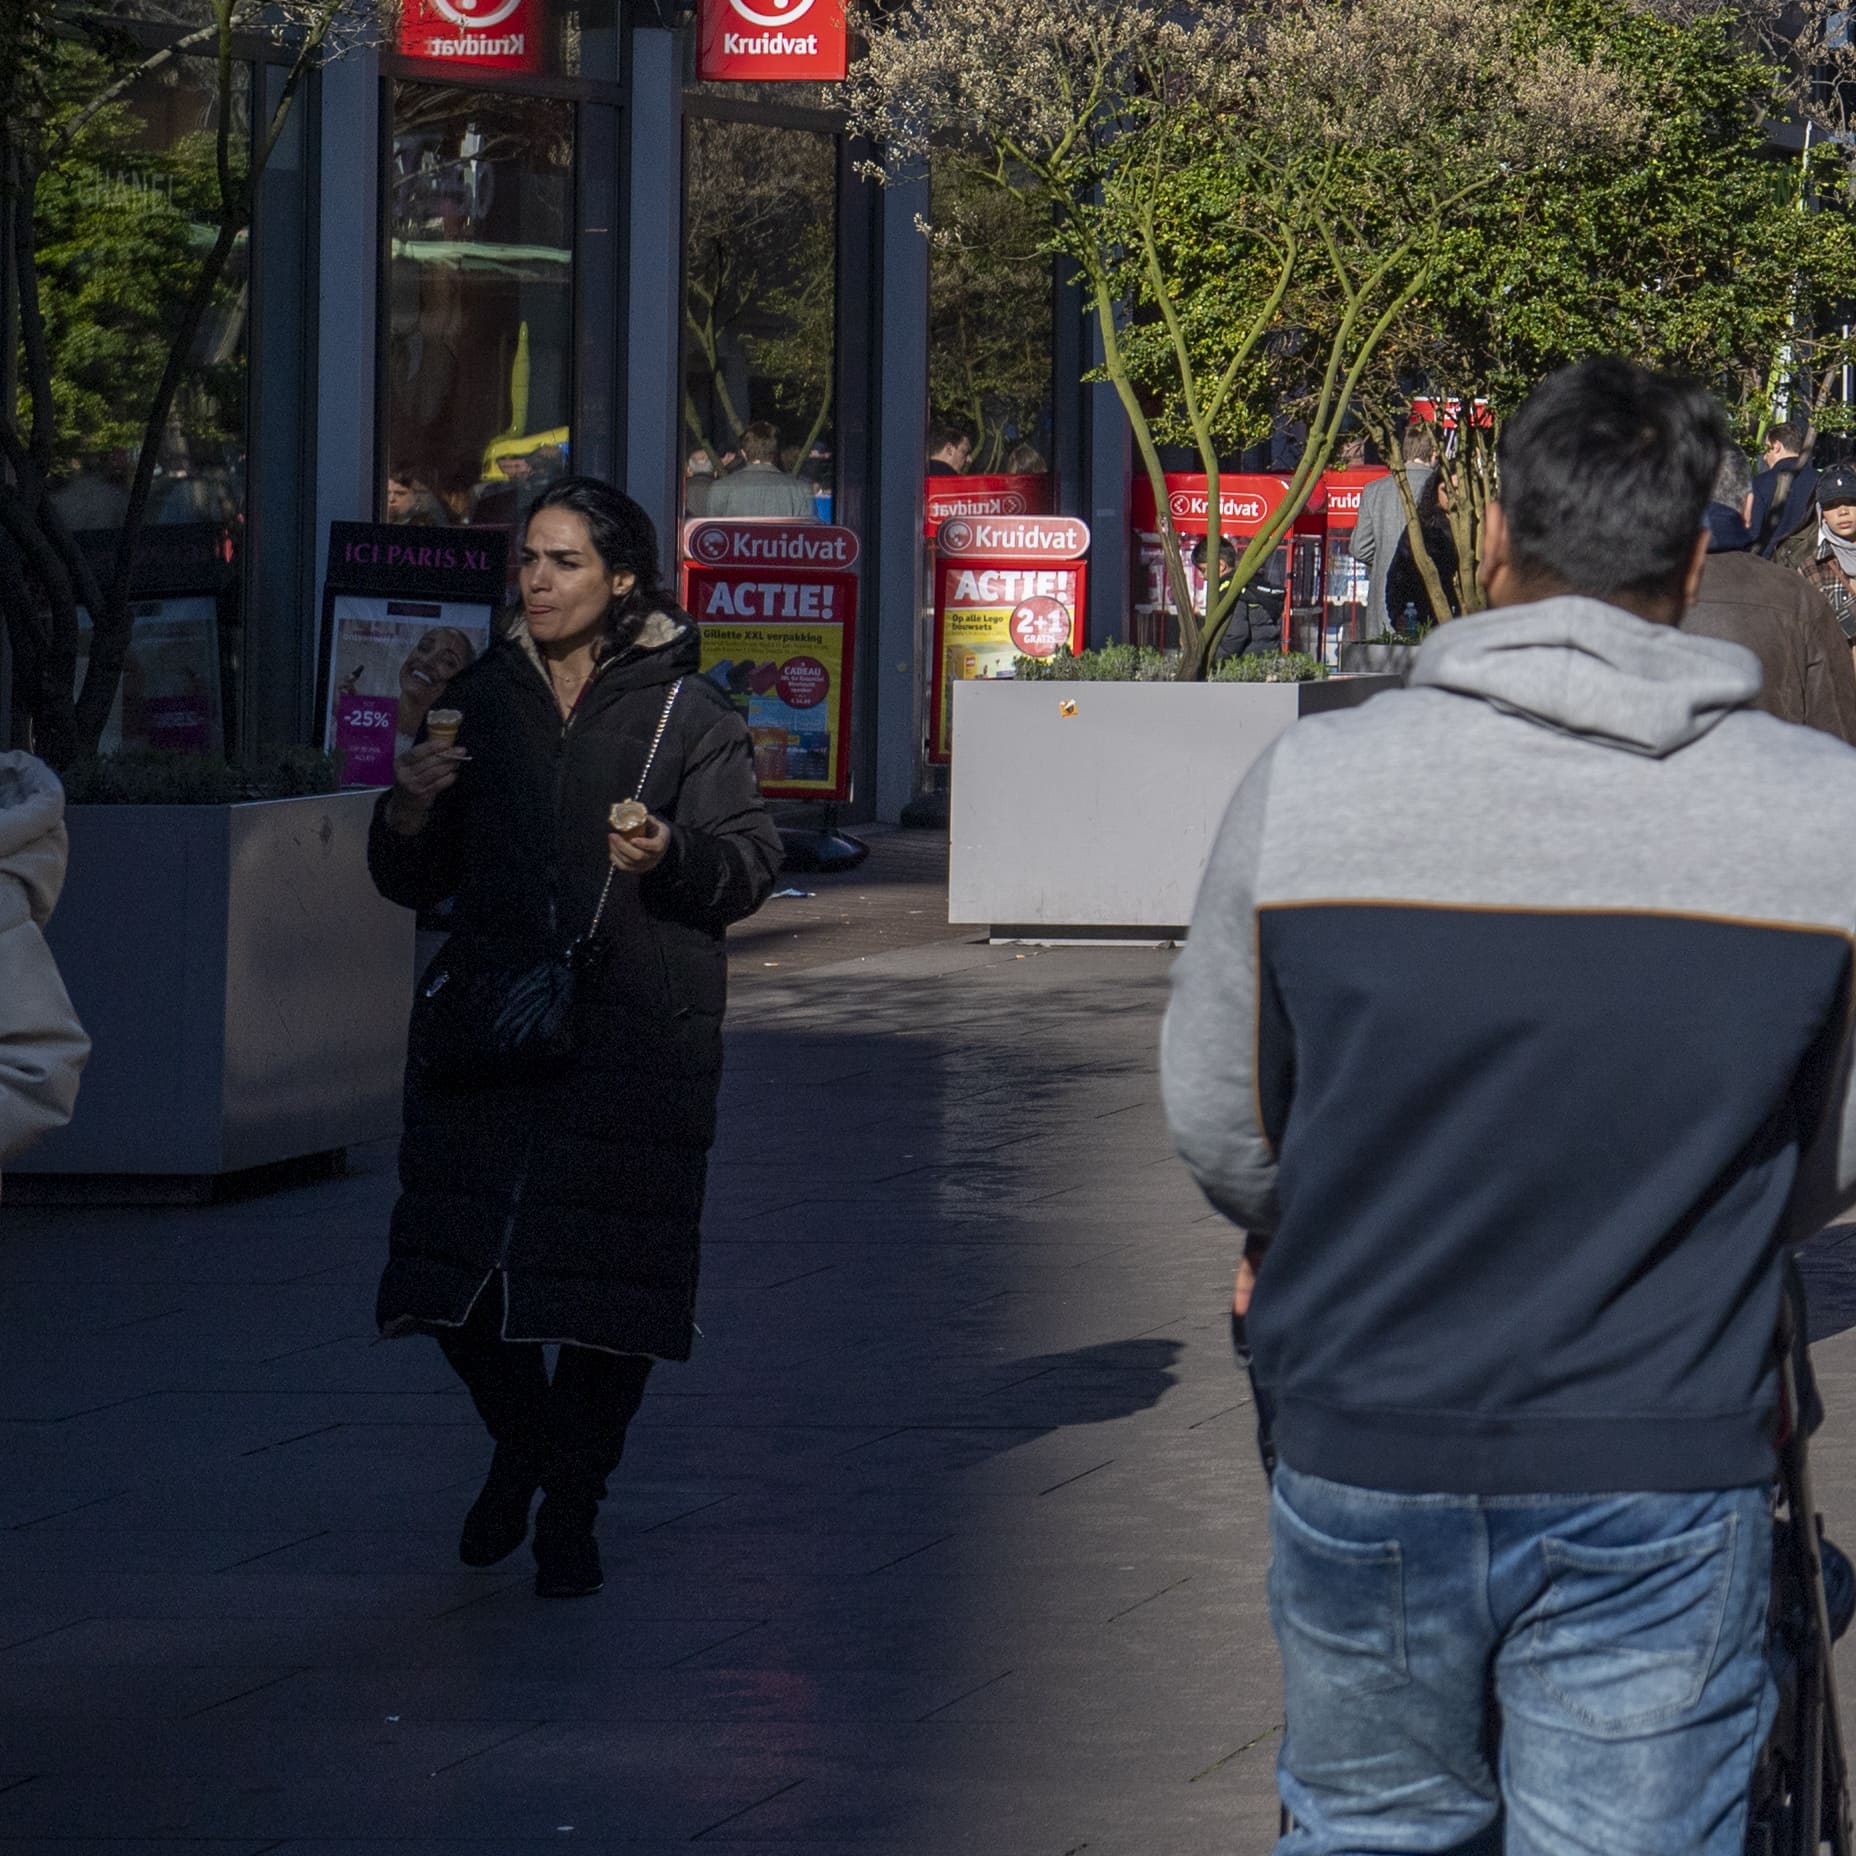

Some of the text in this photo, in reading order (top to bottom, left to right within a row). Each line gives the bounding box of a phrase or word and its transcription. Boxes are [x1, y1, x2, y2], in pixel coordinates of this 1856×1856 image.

[724, 32, 818, 56] Kruidvat
[1191, 497, 1259, 517] Kridvat
[733, 532, 847, 560] Kruidvat
[976, 525, 1077, 549] Kruidvat
[345, 543, 491, 570] ICI PARIS XL
[954, 570, 1068, 602] ACTIE!
[706, 582, 834, 619] ACTIE!
[952, 614, 1004, 624] Op alle Lego
[1017, 608, 1062, 633] 2+1
[703, 629, 822, 644] Gillette XXL verpakking
[784, 667, 822, 676] CADEAU
[344, 710, 389, 728] -25%
